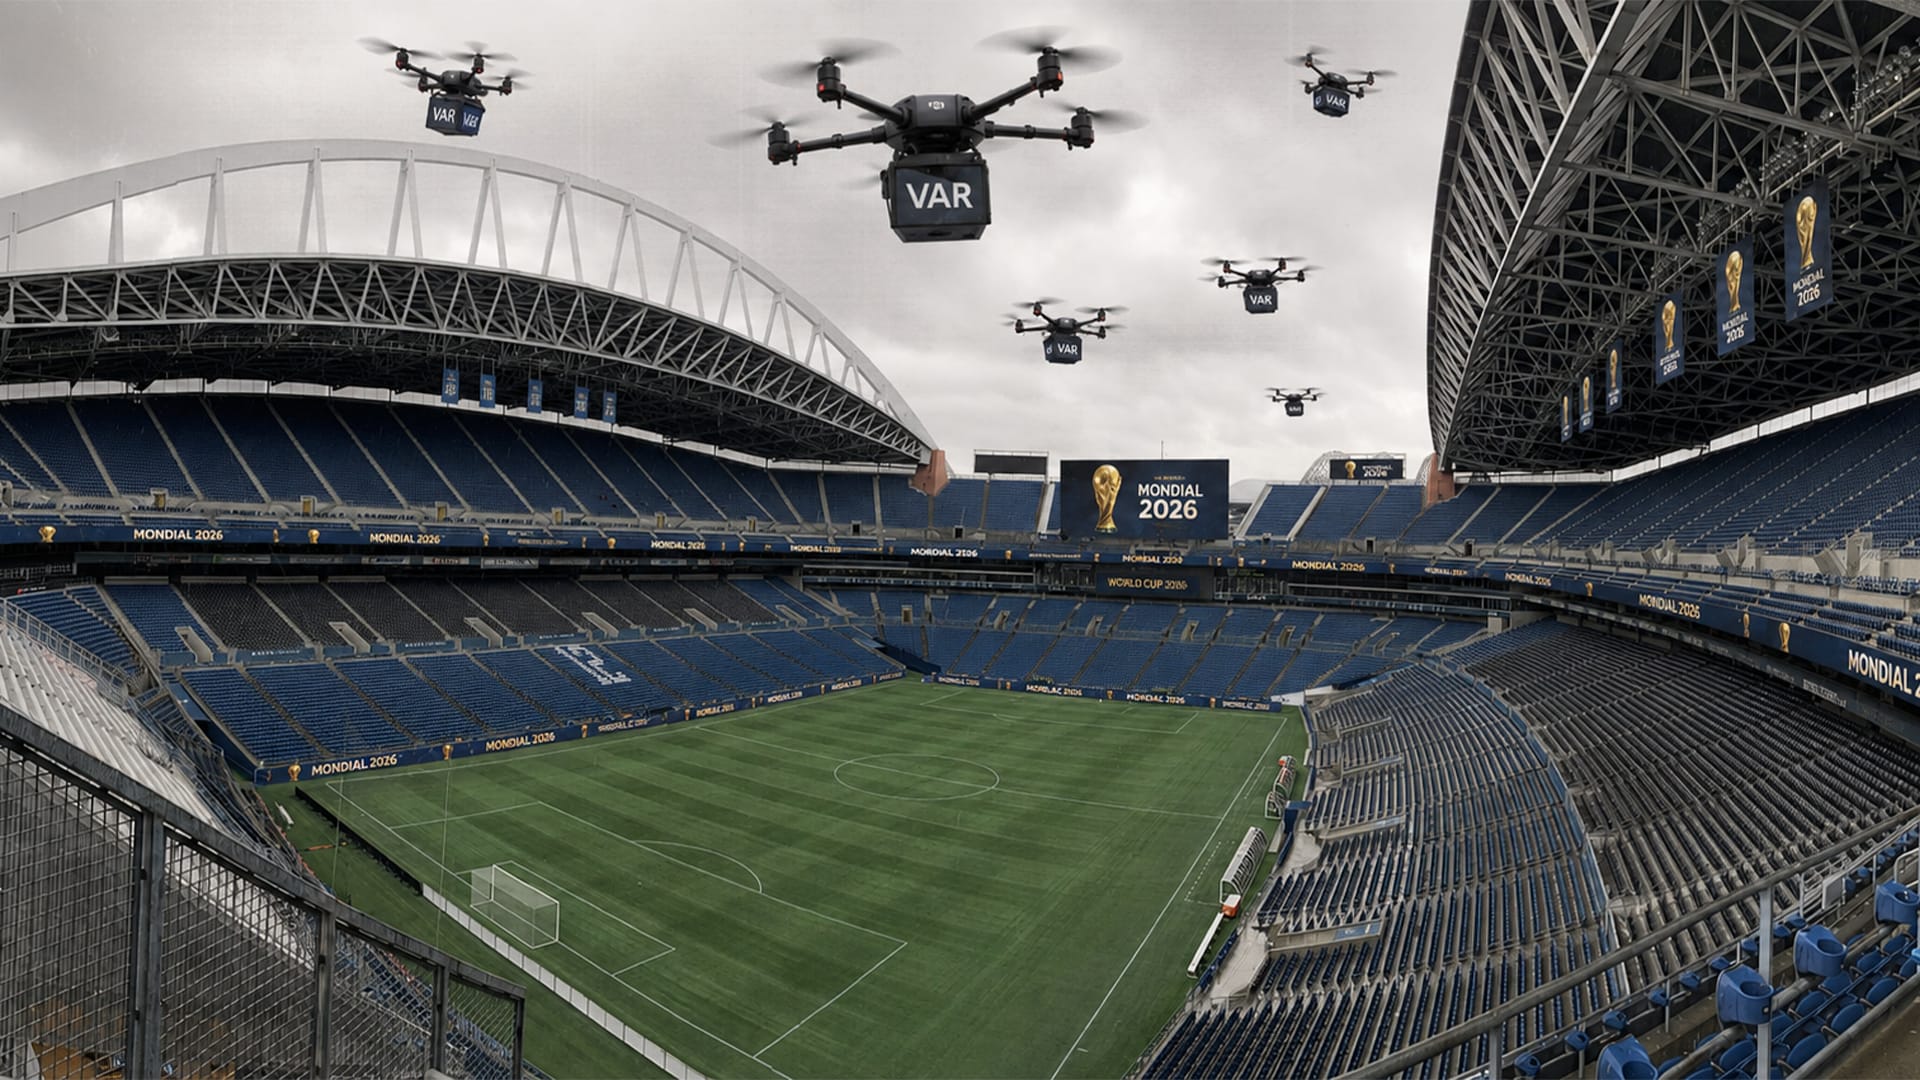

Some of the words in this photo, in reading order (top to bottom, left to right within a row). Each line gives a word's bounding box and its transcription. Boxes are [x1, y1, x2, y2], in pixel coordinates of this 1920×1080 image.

[432, 106, 456, 124] VAR
[905, 182, 974, 209] VAR
[1249, 294, 1273, 305] VAR
[1057, 343, 1078, 356] VAR
[1137, 483, 1203, 498] MONDIAL
[1138, 499, 1198, 520] 2026
[133, 529, 192, 540] MONDIAL
[195, 529, 223, 540] 2026
[369, 533, 415, 543] MONDIAL
[417, 533, 441, 545] 2026
[1143, 578, 1163, 589] CUP
[1848, 648, 1912, 695] MONDIAL
[486, 735, 531, 752] MONDIAL
[311, 758, 367, 776] MONDIAL
[370, 753, 398, 769] 2026
